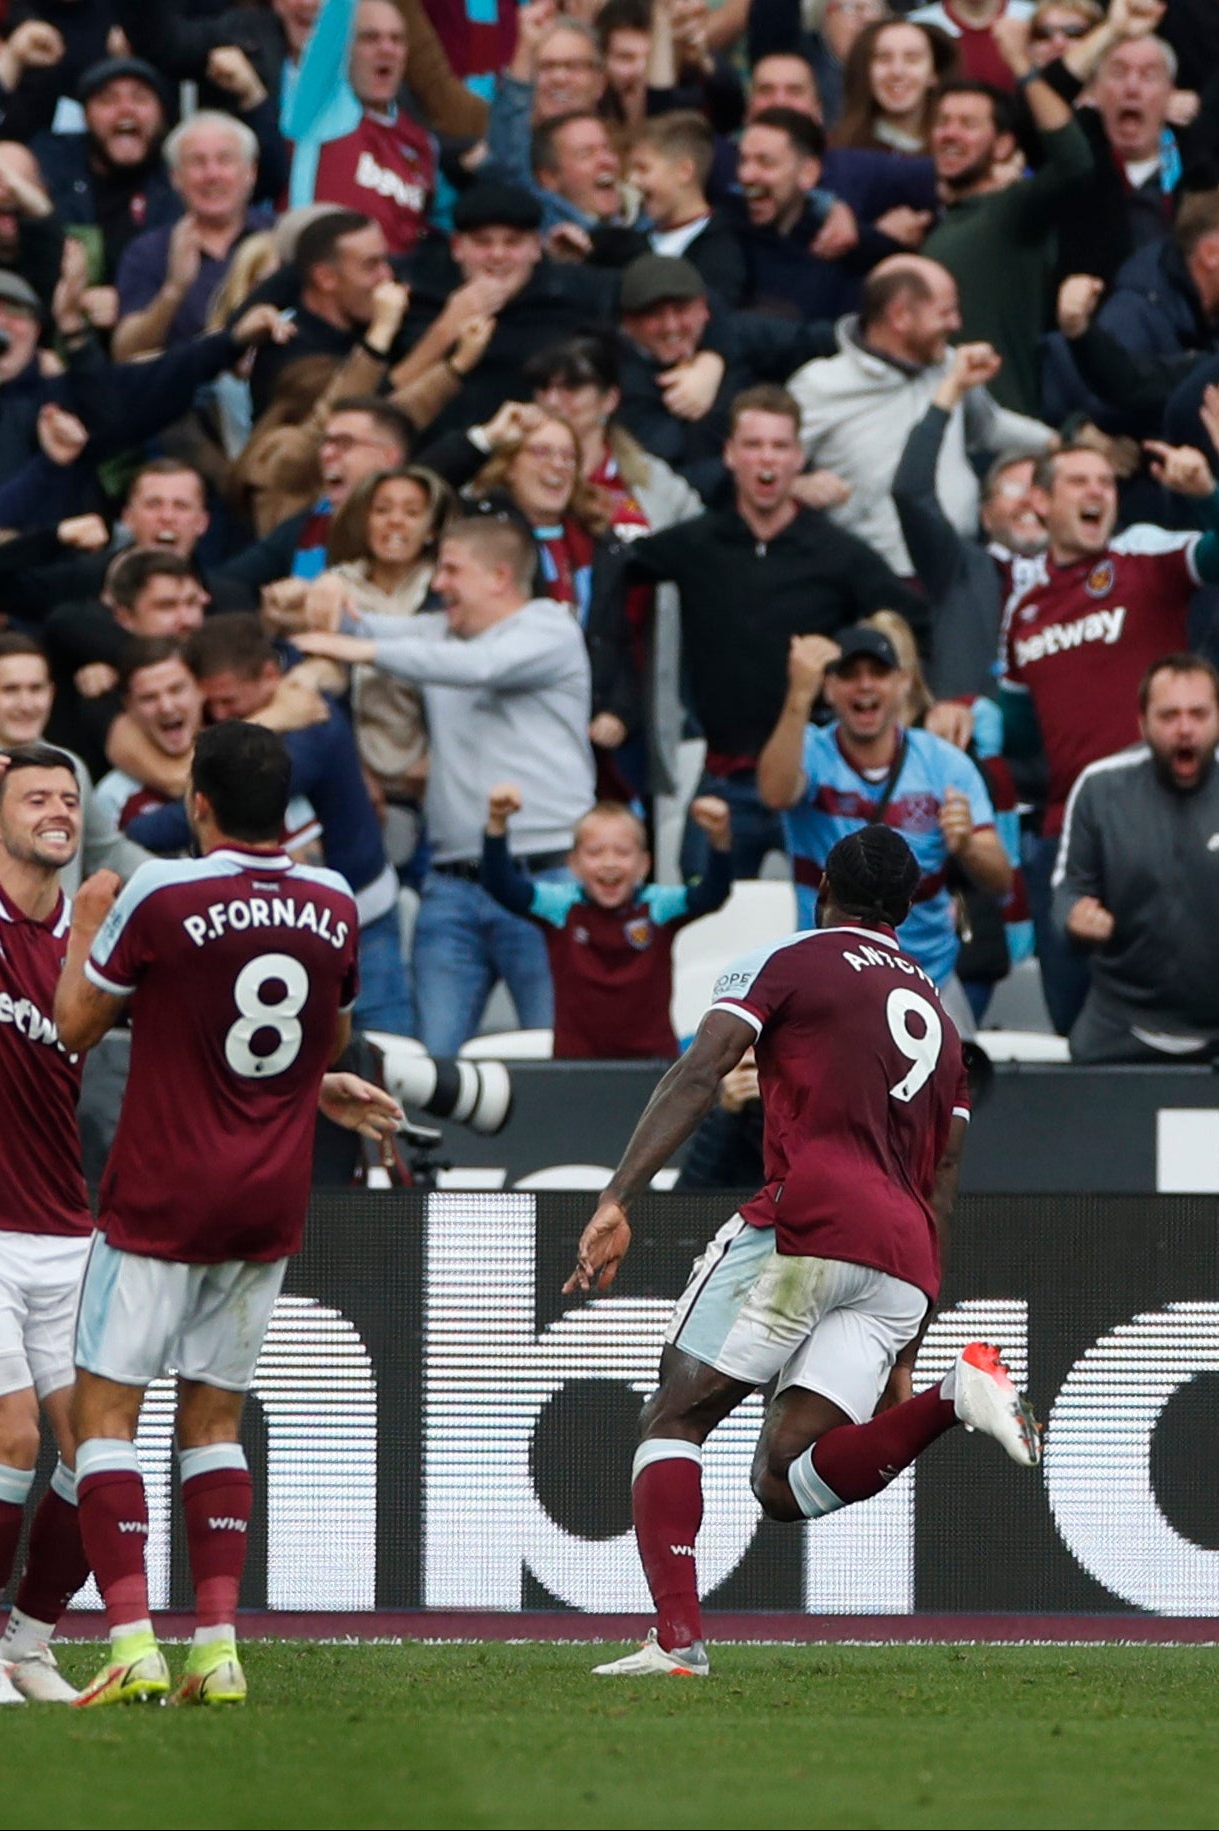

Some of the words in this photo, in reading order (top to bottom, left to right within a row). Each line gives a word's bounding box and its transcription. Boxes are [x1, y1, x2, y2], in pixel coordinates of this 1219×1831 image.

[183, 898, 349, 947] P.FORNALS
[225, 952, 310, 1079] 8
[886, 987, 943, 1102] 9
[118, 1521, 148, 1534] WH
